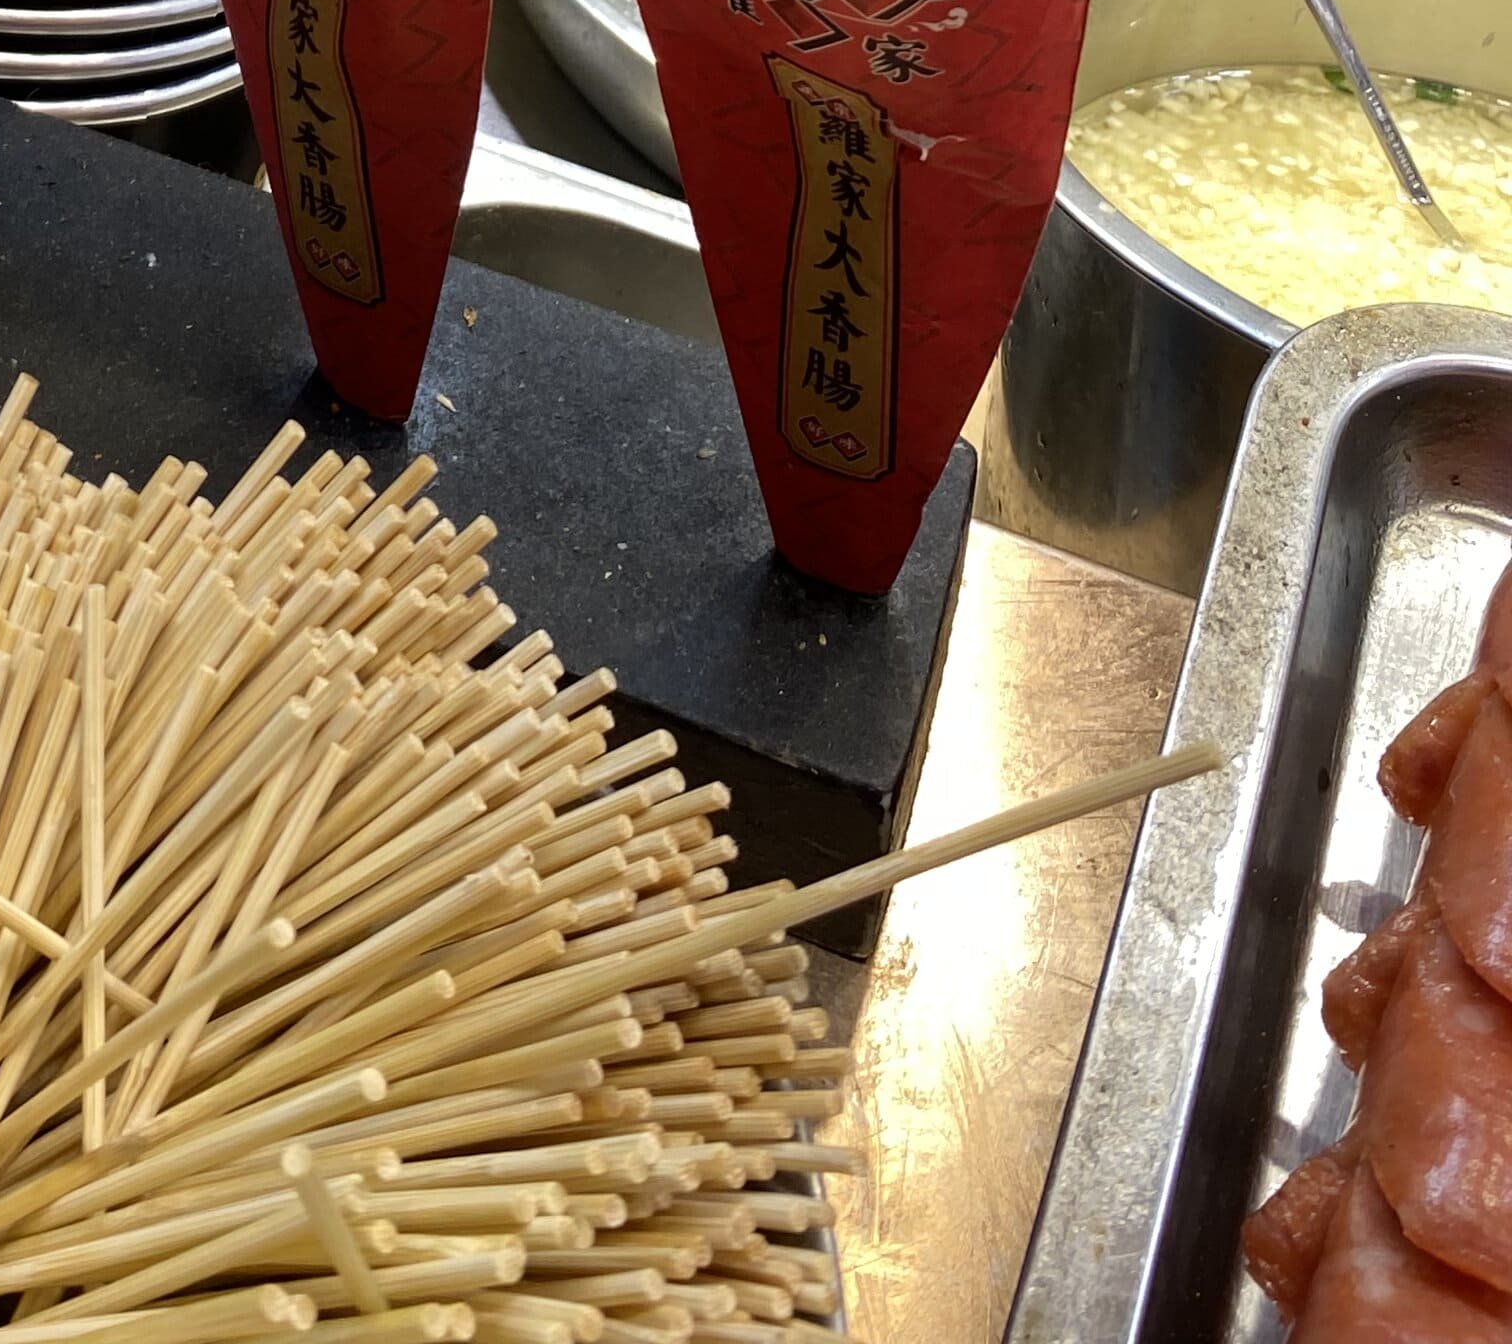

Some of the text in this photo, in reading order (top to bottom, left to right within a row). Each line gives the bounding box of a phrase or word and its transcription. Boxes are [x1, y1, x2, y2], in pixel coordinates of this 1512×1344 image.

[862, 32, 945, 84] 家
[800, 109, 877, 412] 羅家大香腸
